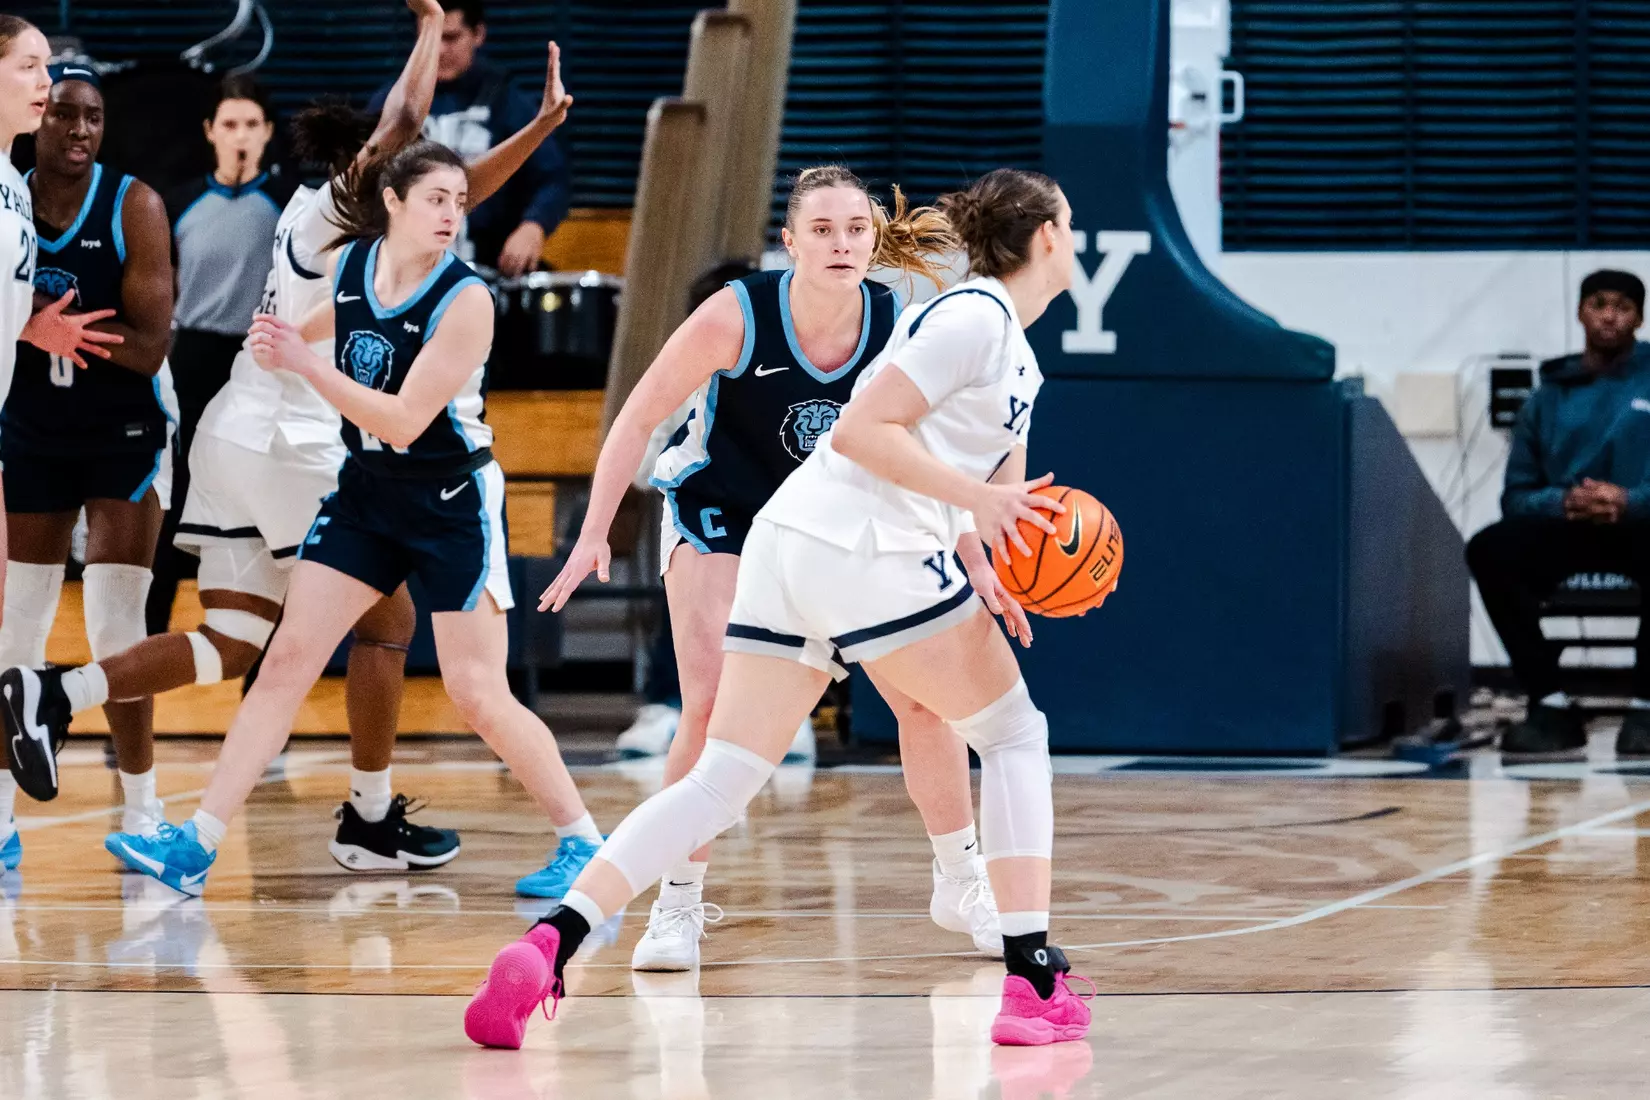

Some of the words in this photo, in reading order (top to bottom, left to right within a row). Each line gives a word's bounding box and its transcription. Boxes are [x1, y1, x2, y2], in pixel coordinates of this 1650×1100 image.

[1062, 230, 1151, 354] Y
[305, 516, 331, 544] C
[700, 507, 727, 538] C
[922, 550, 953, 592] Y
